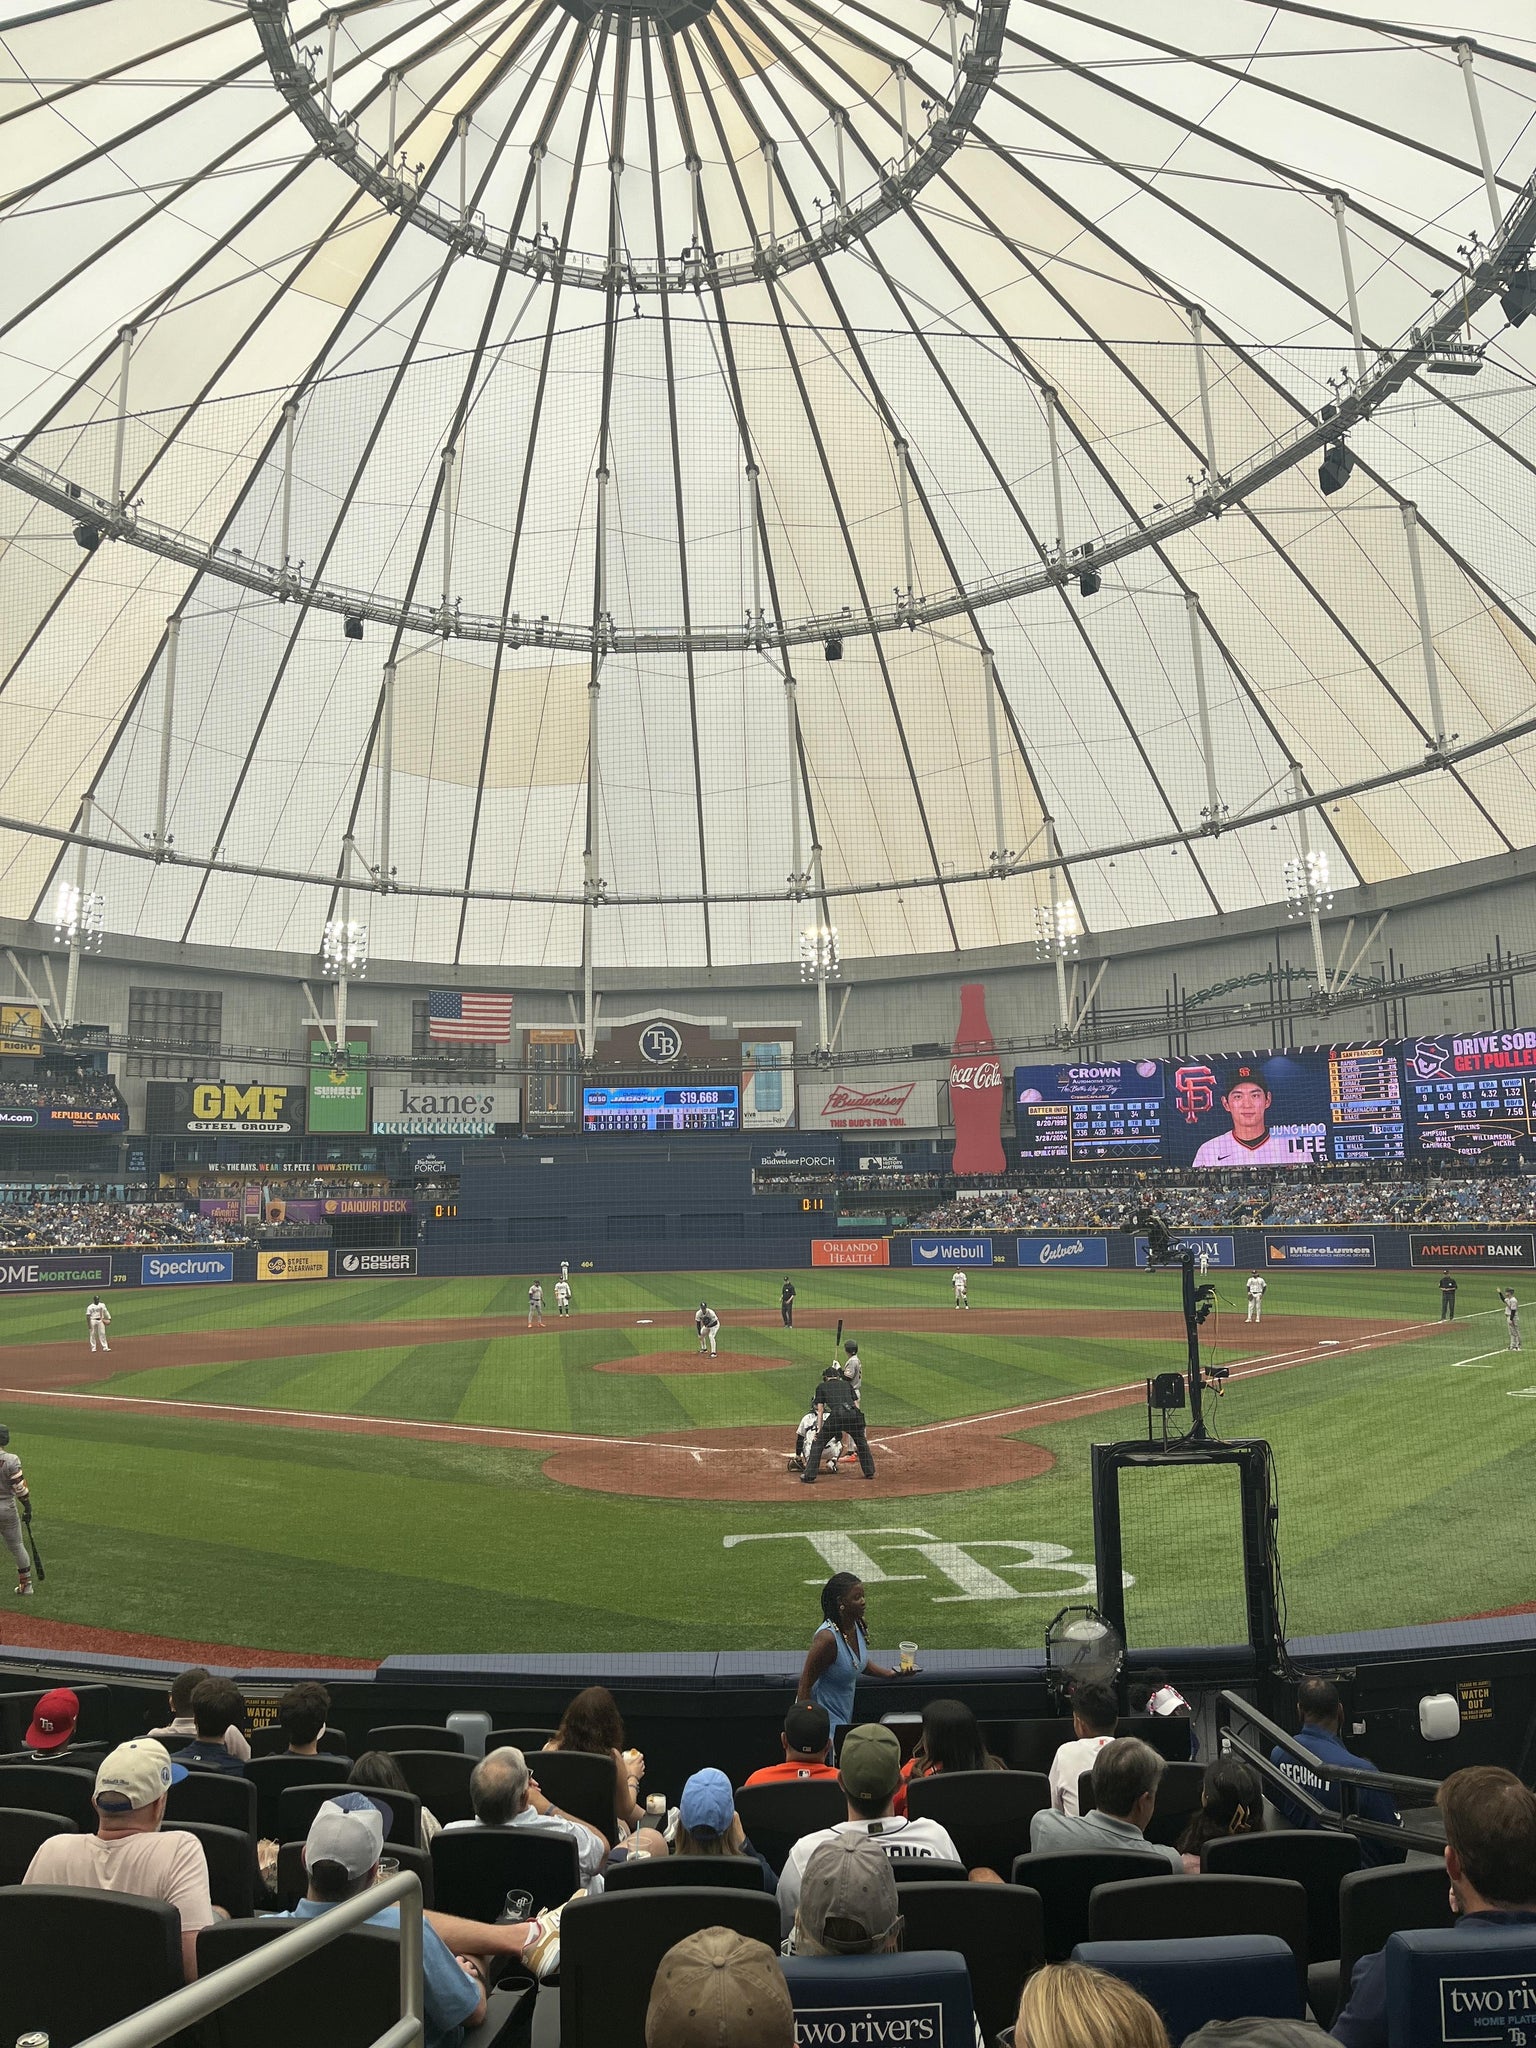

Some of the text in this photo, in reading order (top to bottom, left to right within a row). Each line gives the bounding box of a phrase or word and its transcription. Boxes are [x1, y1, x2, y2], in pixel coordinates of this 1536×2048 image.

[648, 1030, 675, 1056] TB
[1453, 1036, 1499, 1056] DRIVE
[1454, 1049, 1536, 1072] GET PULLE
[950, 1062, 1002, 1089] Coca-Cola
[1069, 1068, 1121, 1078] CROWN
[314, 1086, 364, 1096] SUNBELT
[1176, 1066, 1217, 1124] SF
[1506, 1088, 1520, 1096] 1.32
[193, 1084, 287, 1120] GMF
[400, 1088, 495, 1114] kane's
[680, 1092, 718, 1104] $19,668
[829, 1092, 906, 1108] Budweiser
[51, 1111, 94, 1120] REPUBLIC
[96, 1112, 120, 1120] BANK
[720, 1110, 734, 1120] 1-2
[1460, 1110, 1476, 1118] 5.63
[1506, 1108, 1523, 1116] 7.56
[242, 1123, 284, 1131] GROUP
[849, 1118, 872, 1127] BUD'S
[873, 1118, 888, 1126] FOR
[889, 1118, 906, 1126] YOU.
[1272, 1123, 1326, 1136] JUNG HOO
[1290, 1136, 1326, 1153] LEE
[800, 1156, 835, 1166] PORCH
[414, 1164, 446, 1172] PORCH
[341, 1200, 407, 1213] DAIQUIRI DECK
[435, 1204, 457, 1217] 0:11
[803, 1199, 823, 1210] 0:11
[824, 1242, 878, 1252] ORLANDO
[941, 1245, 984, 1258] Webull
[1039, 1240, 1084, 1263] Culver's
[1421, 1245, 1522, 1256] AMERANT BANK
[830, 1253, 872, 1263] HEALTH
[150, 1260, 220, 1278] Spectrum
[39, 1270, 102, 1282] MORTGAGE
[1461, 1689, 1489, 1699] WATCH
[1468, 1699, 1483, 1709] OUT
[247, 1707, 277, 1717] WATCH
[40, 1718, 54, 1732] TB
[253, 1719, 270, 1727] OUT
[1450, 1988, 1503, 2012] two
[1474, 2017, 1505, 2026] HOME
[794, 2012, 934, 2044] two rivers
[1508, 2028, 1527, 2046] TB
